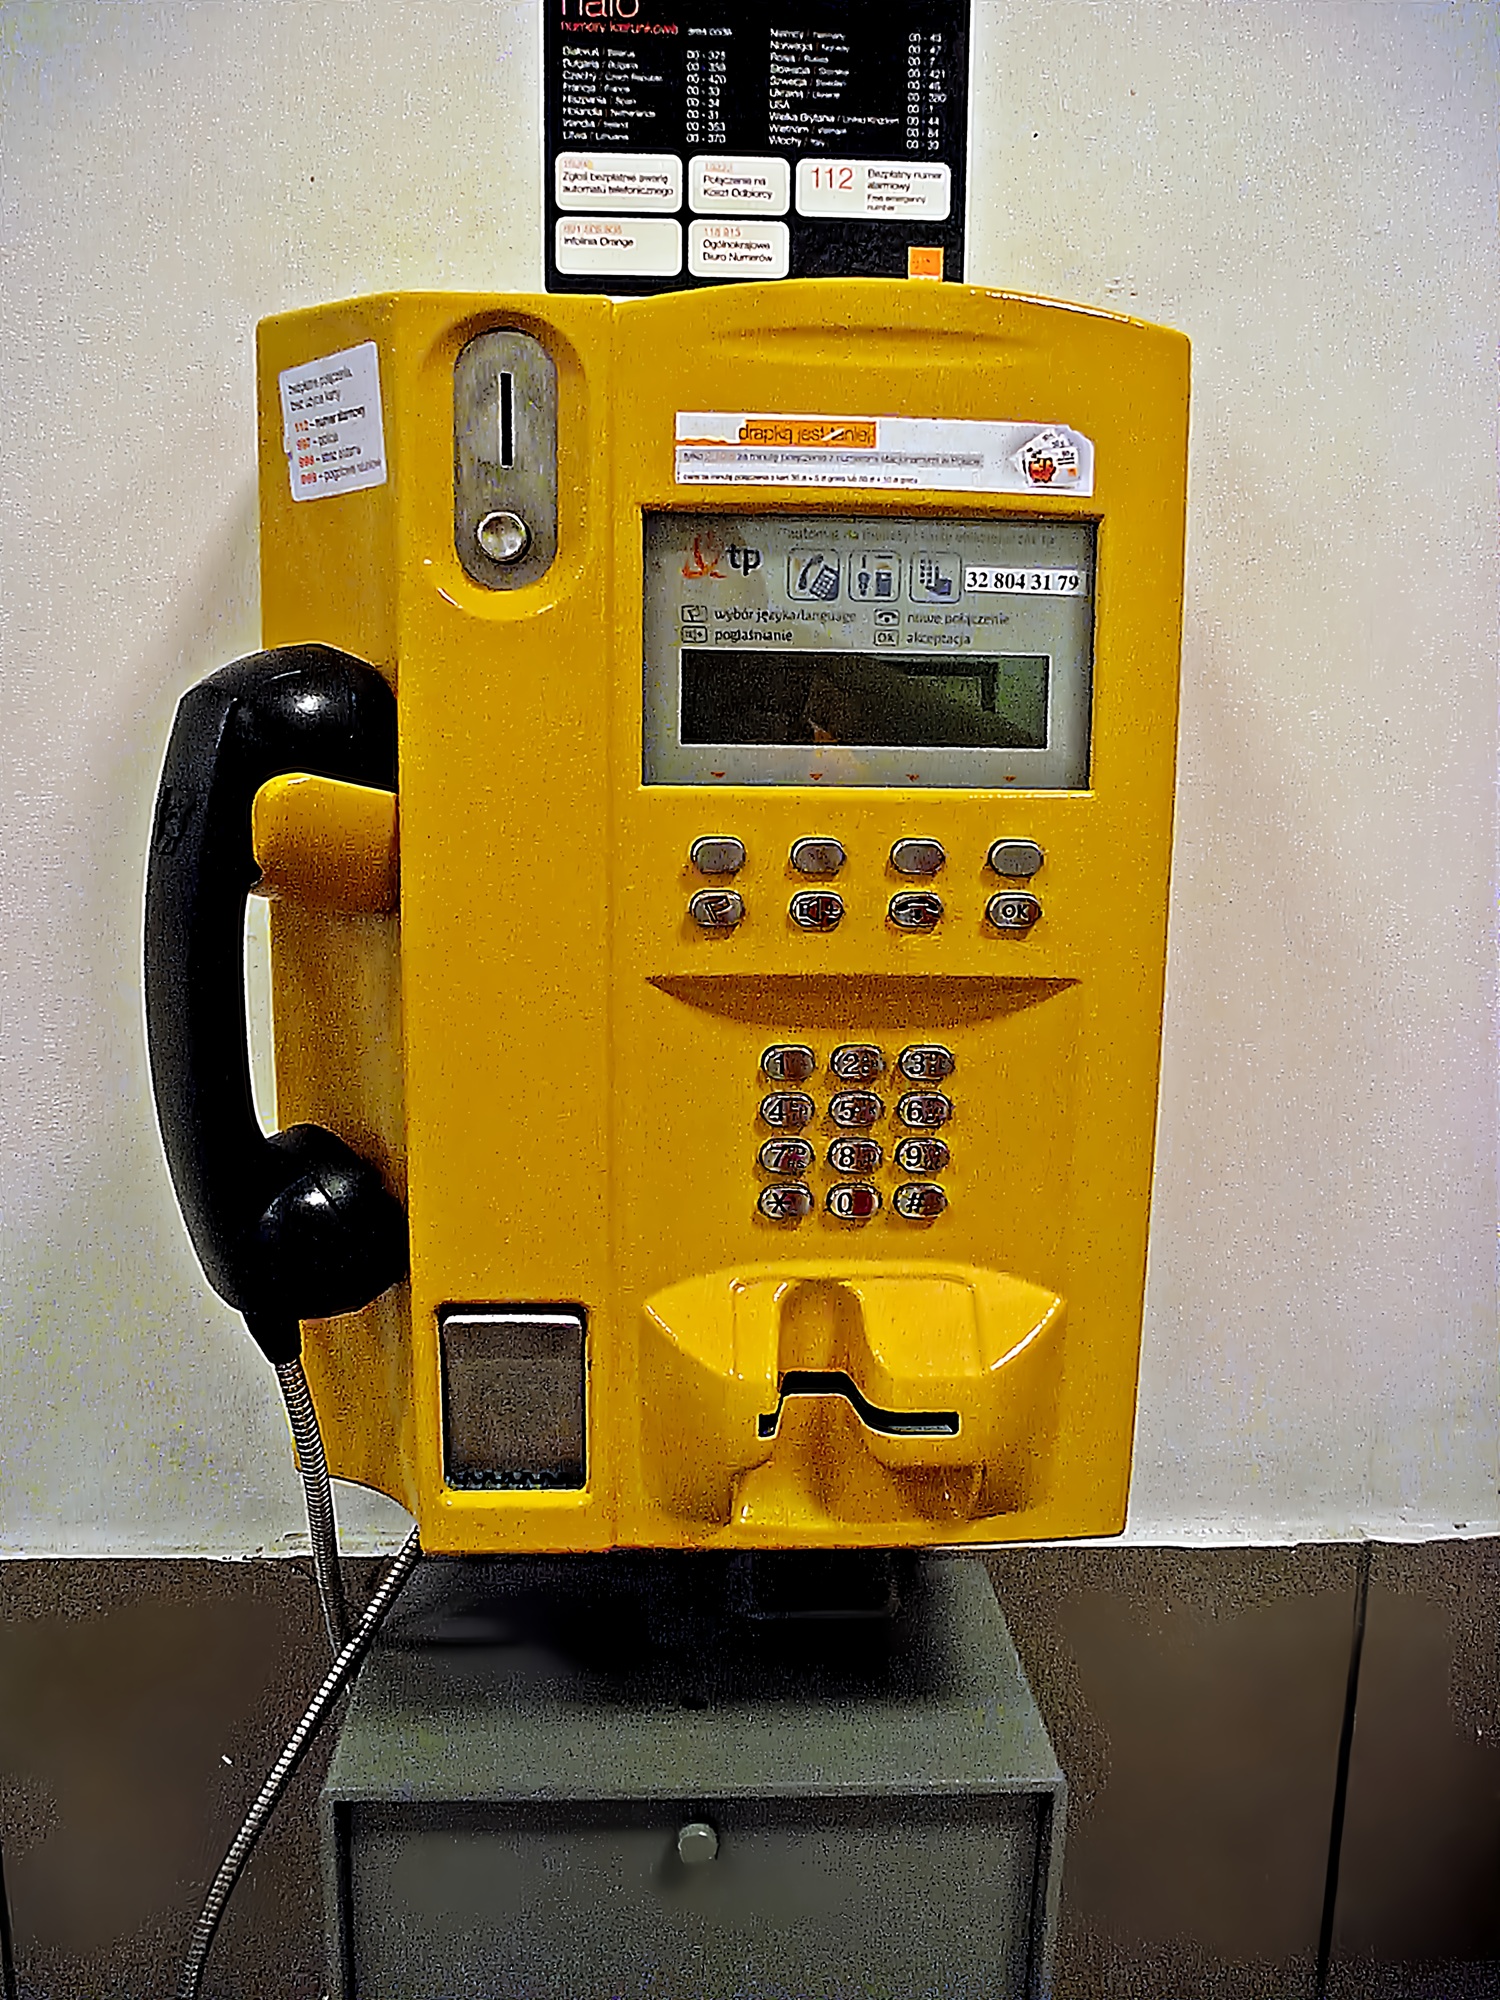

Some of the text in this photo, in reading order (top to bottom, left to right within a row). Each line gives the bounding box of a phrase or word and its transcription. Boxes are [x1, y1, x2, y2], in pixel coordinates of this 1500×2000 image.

[811, 167, 853, 190] 112
[600, 237, 634, 249] Orange
[726, 542, 761, 577] tp
[966, 571, 1080, 591] 32 804 31 79
[714, 606, 754, 626] wybór
[906, 630, 971, 648] akceptacja
[1001, 903, 1030, 921] OK
[842, 1053, 860, 1075] 2
[910, 1053, 926, 1074] 3
[768, 1099, 785, 1121] 4
[839, 1099, 856, 1121] 5
[906, 1099, 923, 1121] 6
[771, 1147, 786, 1169] 7
[838, 1145, 856, 1168] 8
[906, 1145, 923, 1168] 9
[837, 1191, 853, 1215] 0
